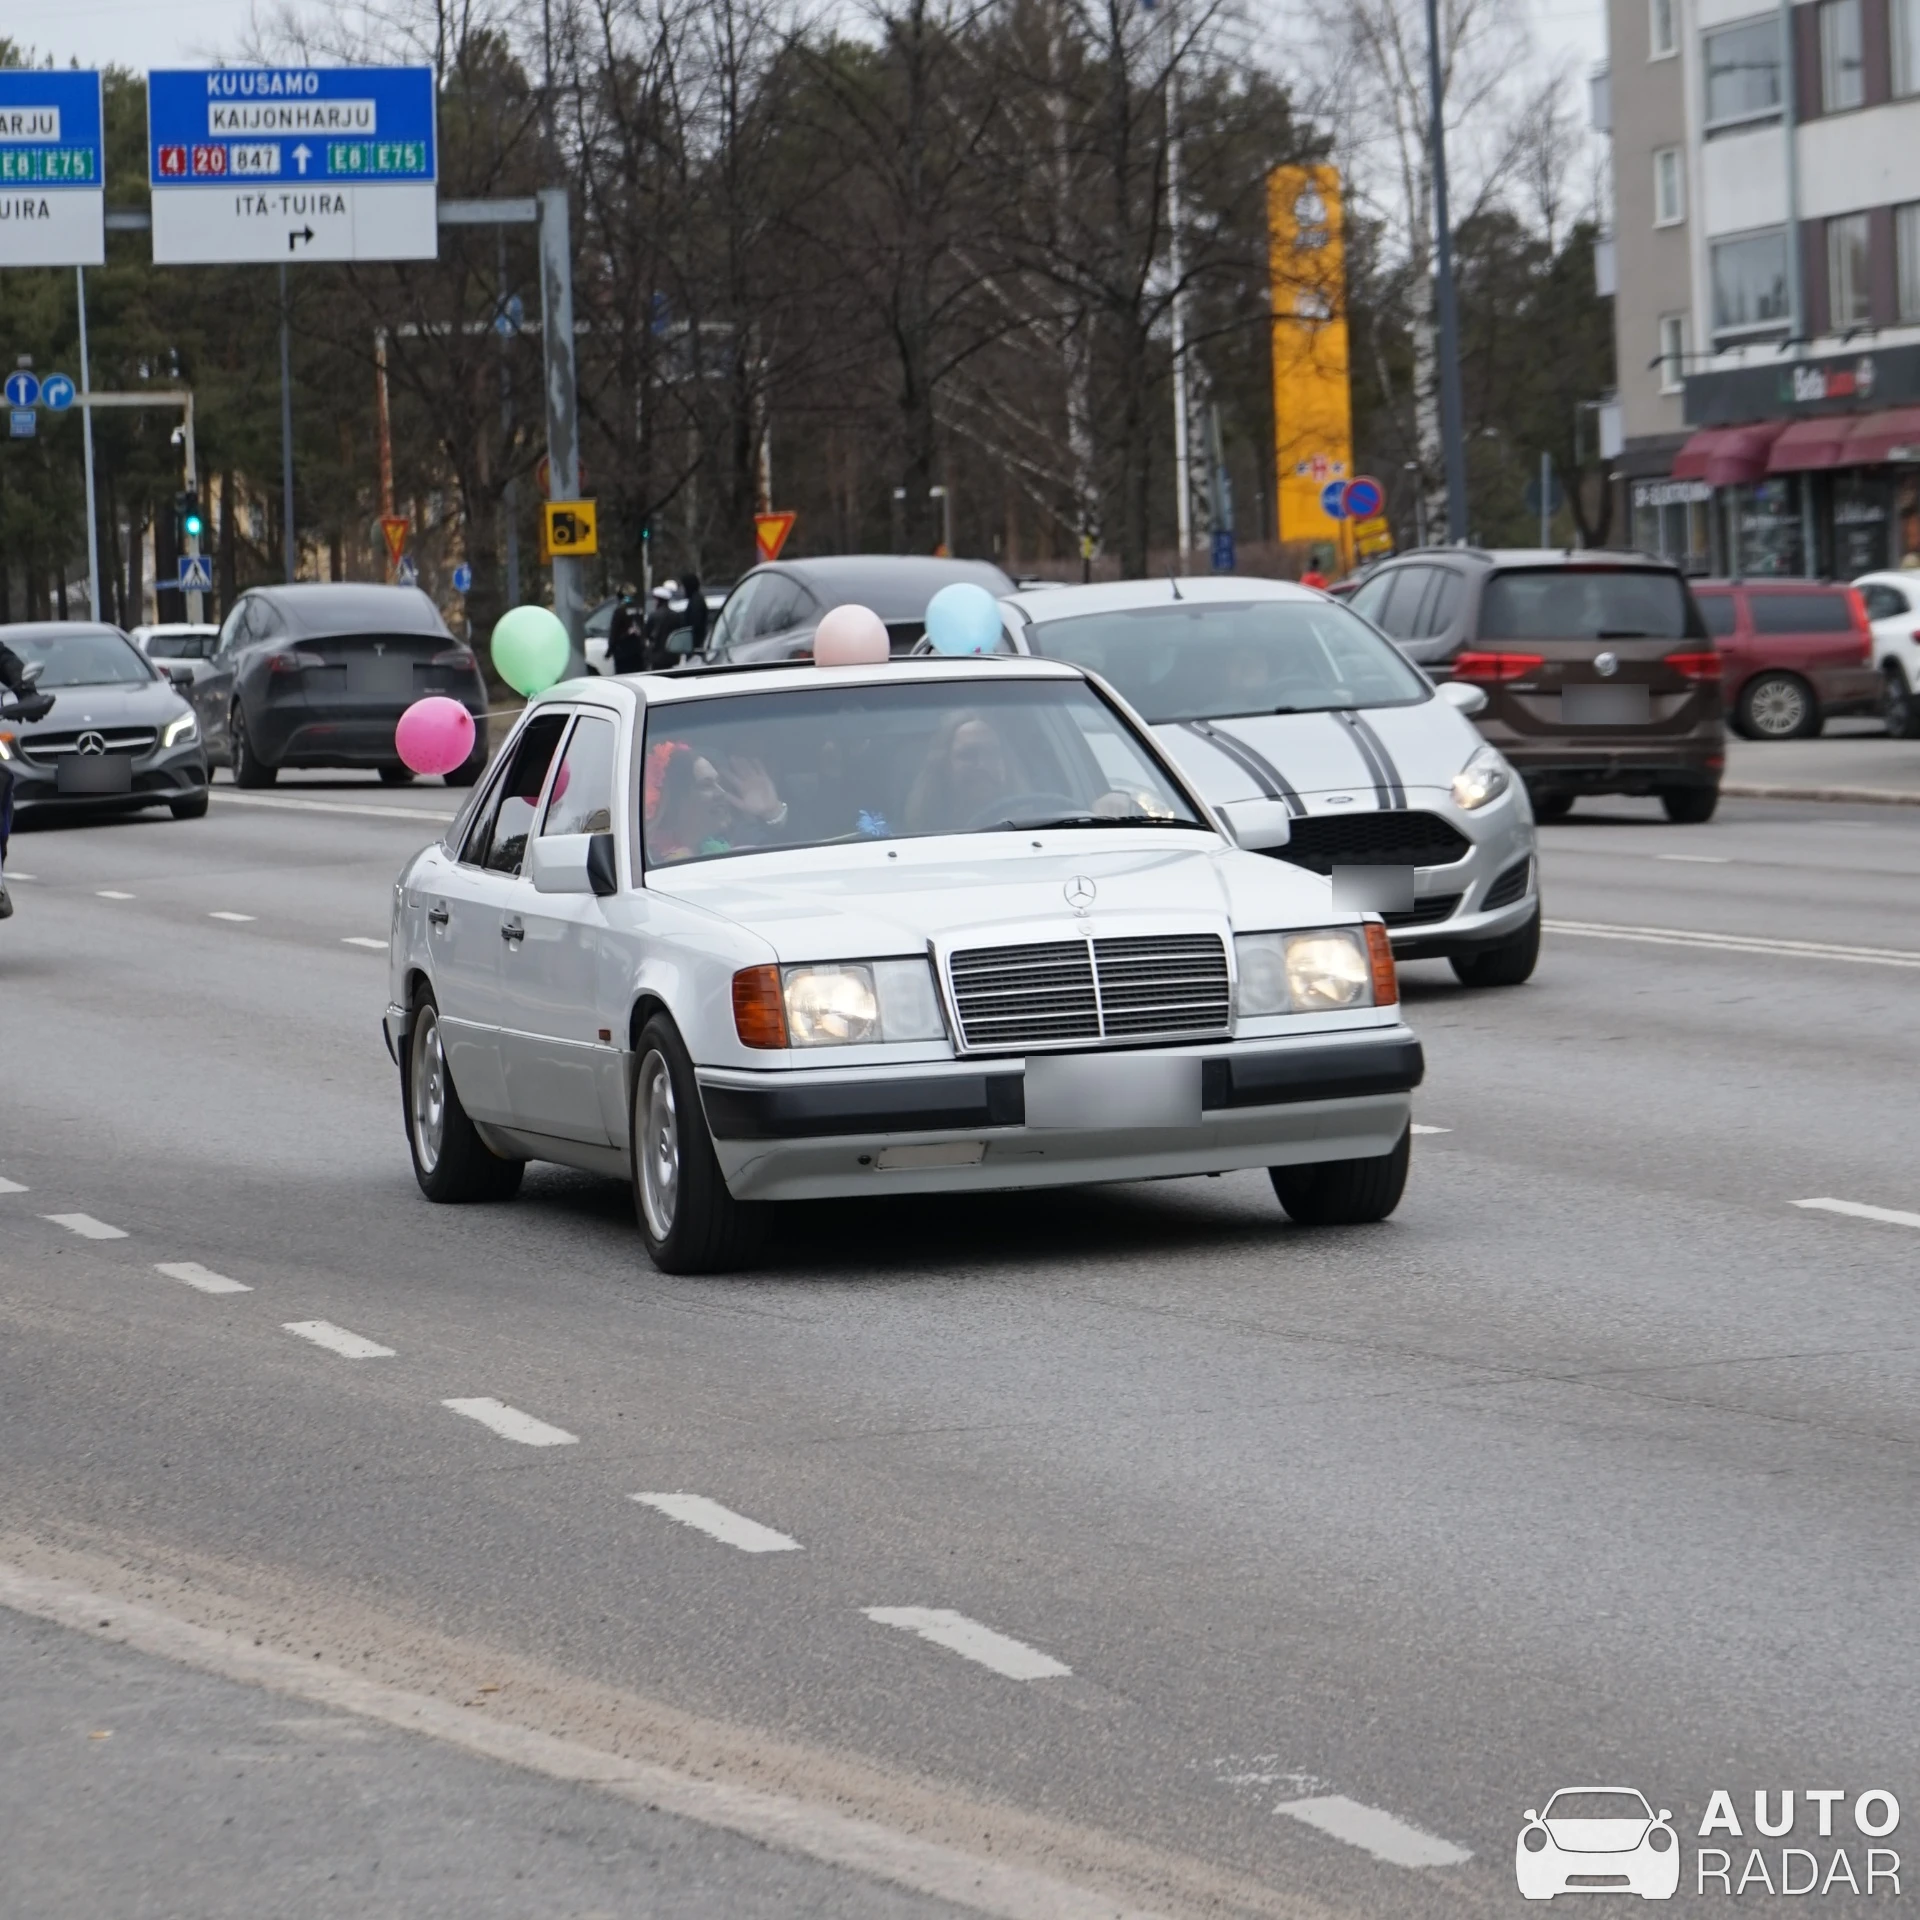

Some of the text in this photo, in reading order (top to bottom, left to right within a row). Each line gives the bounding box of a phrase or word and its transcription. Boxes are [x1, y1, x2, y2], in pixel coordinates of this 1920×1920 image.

[207, 72, 319, 96] KUUSAMO
[213, 106, 370, 130] KAIJONHARJU
[2, 150, 86, 177] E8 E75
[166, 144, 417, 172] 4 20 847 E8 E75
[235, 190, 346, 216] ITÄ-TUIRA
